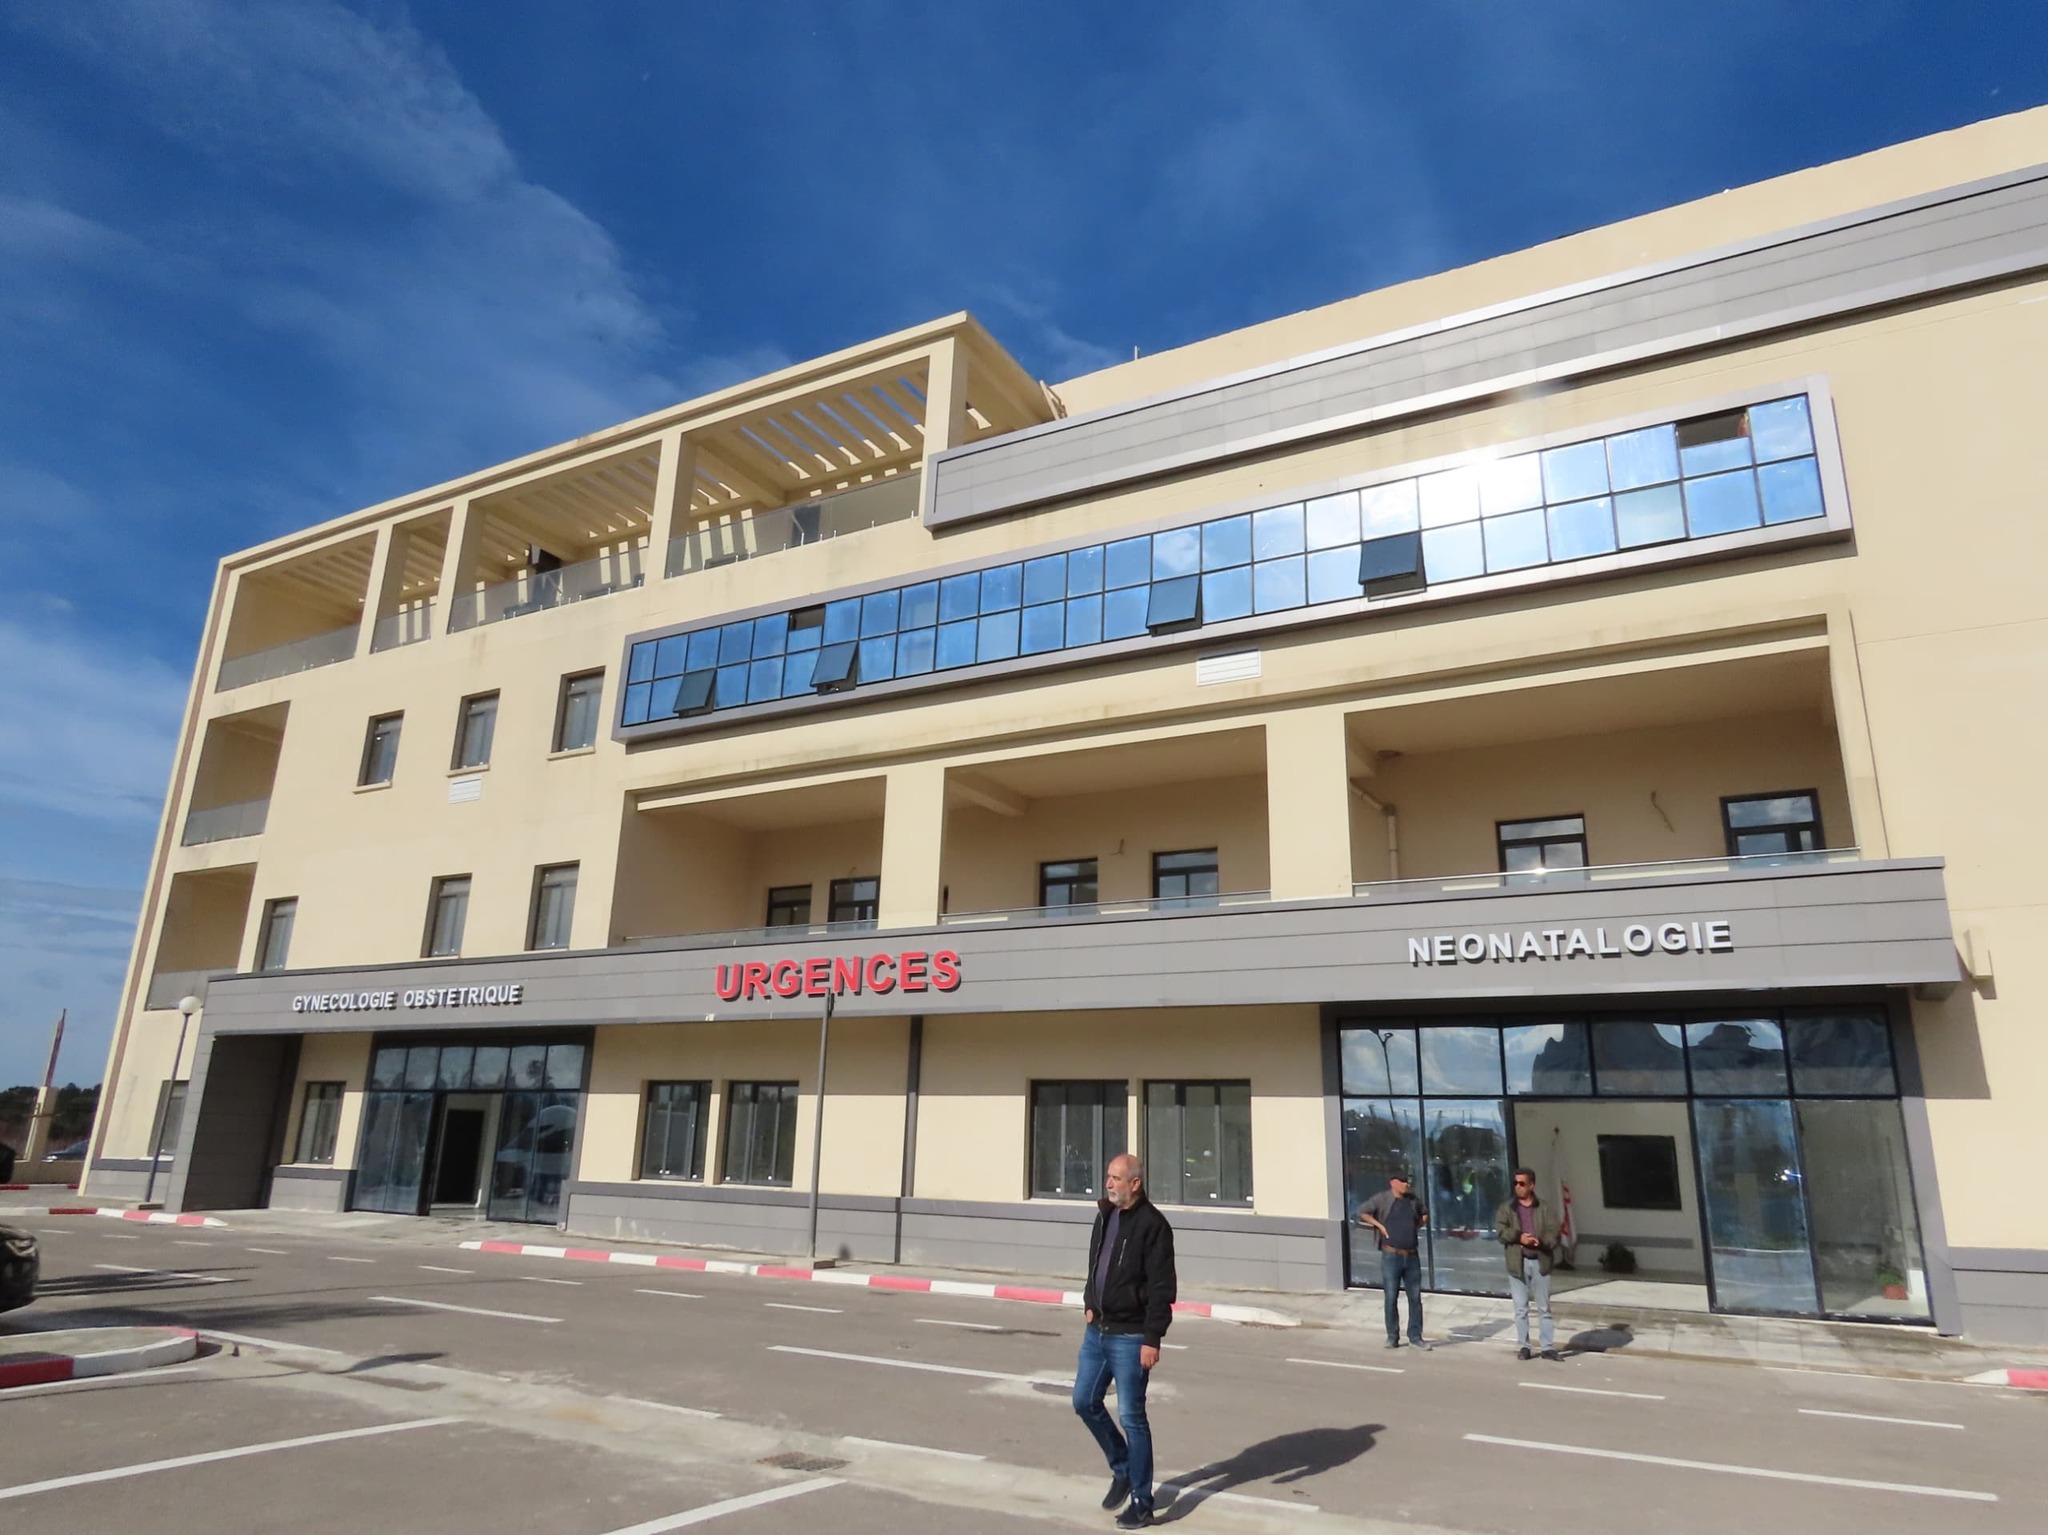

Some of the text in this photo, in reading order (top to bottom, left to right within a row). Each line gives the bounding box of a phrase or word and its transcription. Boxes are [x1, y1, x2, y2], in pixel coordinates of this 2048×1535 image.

[1407, 920, 1733, 963] NEONATALOGIE
[715, 950, 961, 999] URGENCES
[292, 984, 521, 1012] GYNECOLOGIE OBSTETRIQUE
